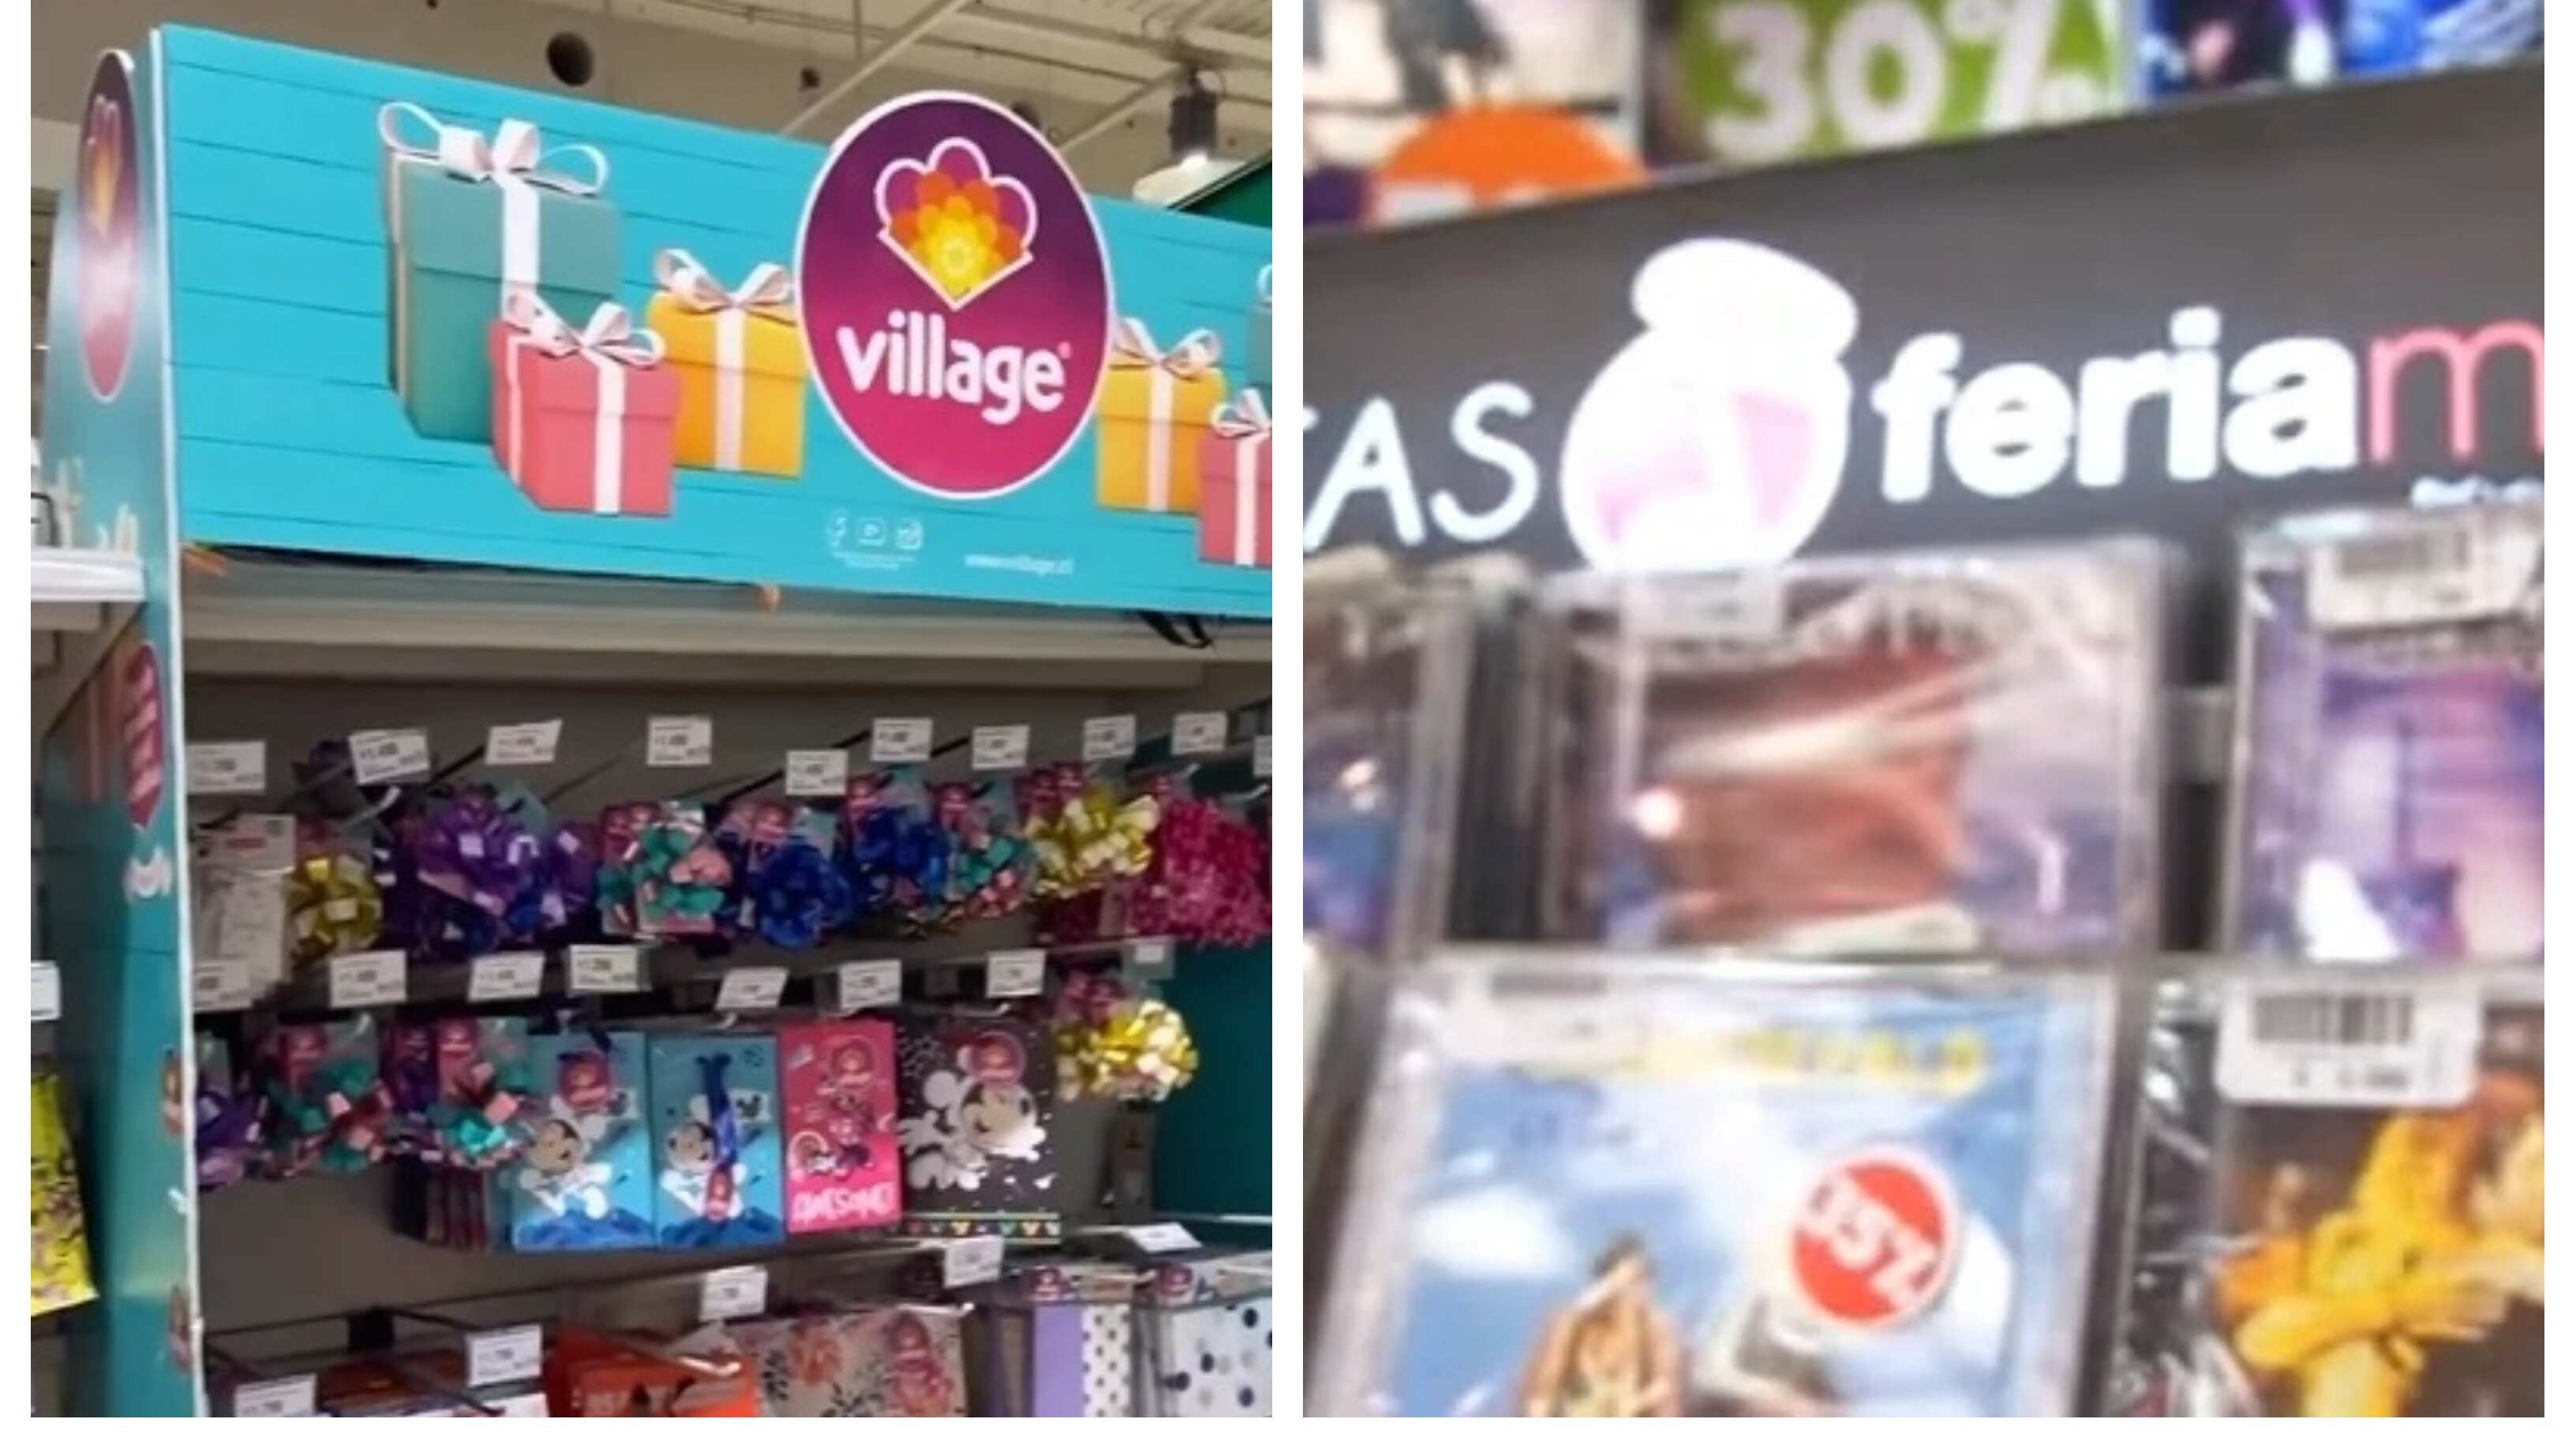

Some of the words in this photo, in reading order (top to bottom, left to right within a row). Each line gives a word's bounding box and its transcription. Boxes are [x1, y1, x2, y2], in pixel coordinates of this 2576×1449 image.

[1705, 0, 2102, 164] 30%
[836, 309, 1065, 425] village
[1303, 381, 1540, 552] AS
